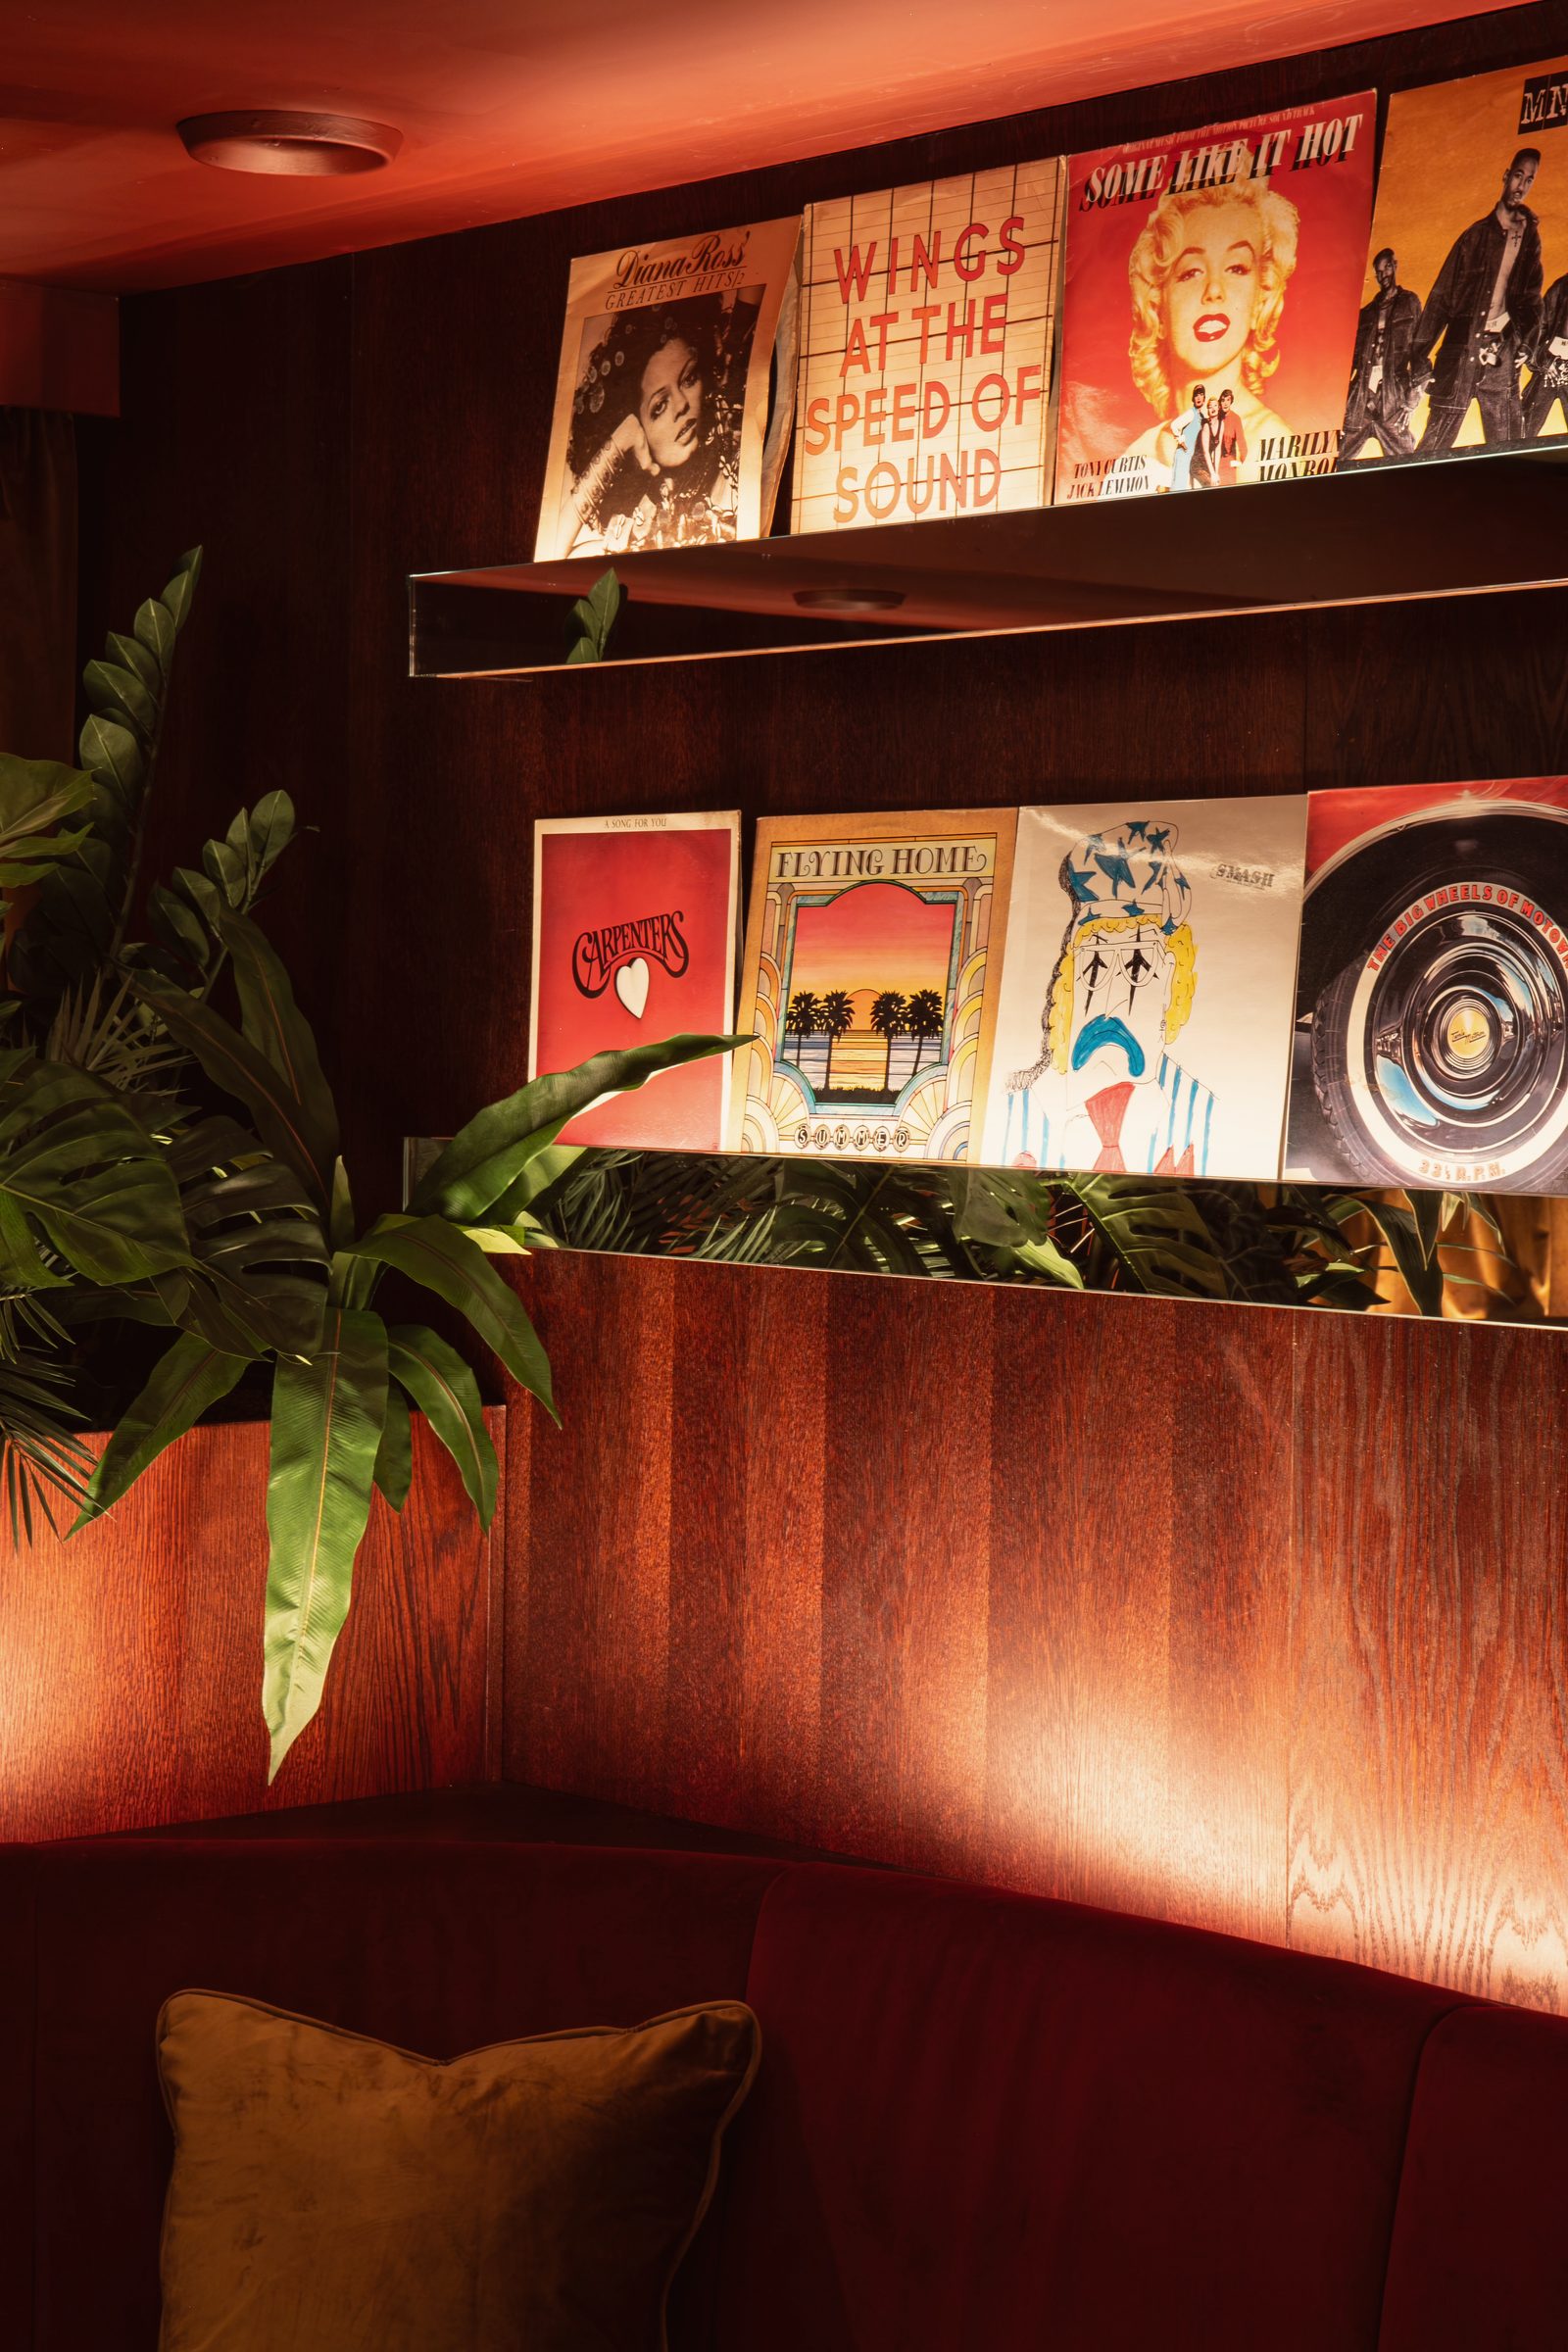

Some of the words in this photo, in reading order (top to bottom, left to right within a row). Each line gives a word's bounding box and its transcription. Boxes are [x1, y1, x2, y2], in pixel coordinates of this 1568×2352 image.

[1085, 155, 1168, 203] SOME
[1172, 138, 1250, 186] LIKE
[1253, 129, 1292, 171] IT
[1296, 114, 1363, 162] HOT
[612, 250, 687, 289] Diana
[833, 217, 1025, 304] WINGS
[605, 280, 687, 311] GREATEST
[839, 313, 899, 378] AT
[911, 294, 1008, 365] THE
[805, 380, 951, 456] SPEED
[971, 365, 1042, 432] OF
[833, 448, 1002, 523] SOUND
[1067, 481, 1094, 499] JACK
[1098, 475, 1149, 496] LEMMON
[1074, 461, 1101, 479] TONY
[1103, 455, 1147, 474] CURTIS
[612, 818, 632, 829] SONG
[635, 818, 648, 828] FOR
[652, 817, 666, 827] YOU
[775, 849, 884, 878] FLYING
[890, 845, 987, 875] HOME
[572, 910, 689, 999] CARPENTERS
[1367, 933, 1396, 971] THE
[1394, 905, 1423, 937] BIG
[1424, 884, 1493, 911] WHEELS
[1496, 889, 1519, 908] OF
[798, 1127, 908, 1149] SUMMER
